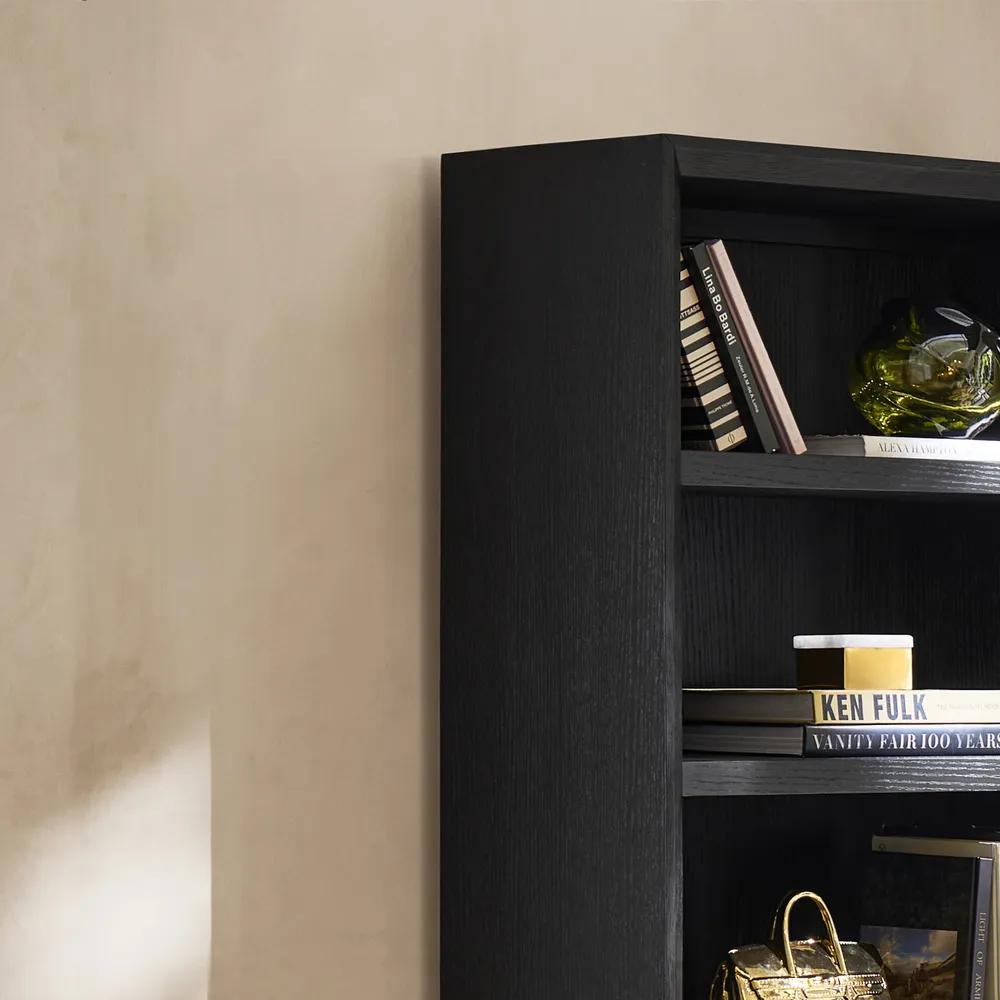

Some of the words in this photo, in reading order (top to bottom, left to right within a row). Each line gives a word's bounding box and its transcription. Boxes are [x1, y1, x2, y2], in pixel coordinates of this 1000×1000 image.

[702, 267, 716, 294] Lina
[712, 295, 724, 311] Bo
[719, 312, 736, 346] Bardi
[821, 694, 864, 721] KEN
[873, 694, 928, 721] FULK
[813, 733, 873, 750] VANITY
[880, 733, 917, 750] FAIR
[921, 733, 951, 750] 100
[978, 912, 987, 944] LIGHT
[976, 951, 984, 967] OF
